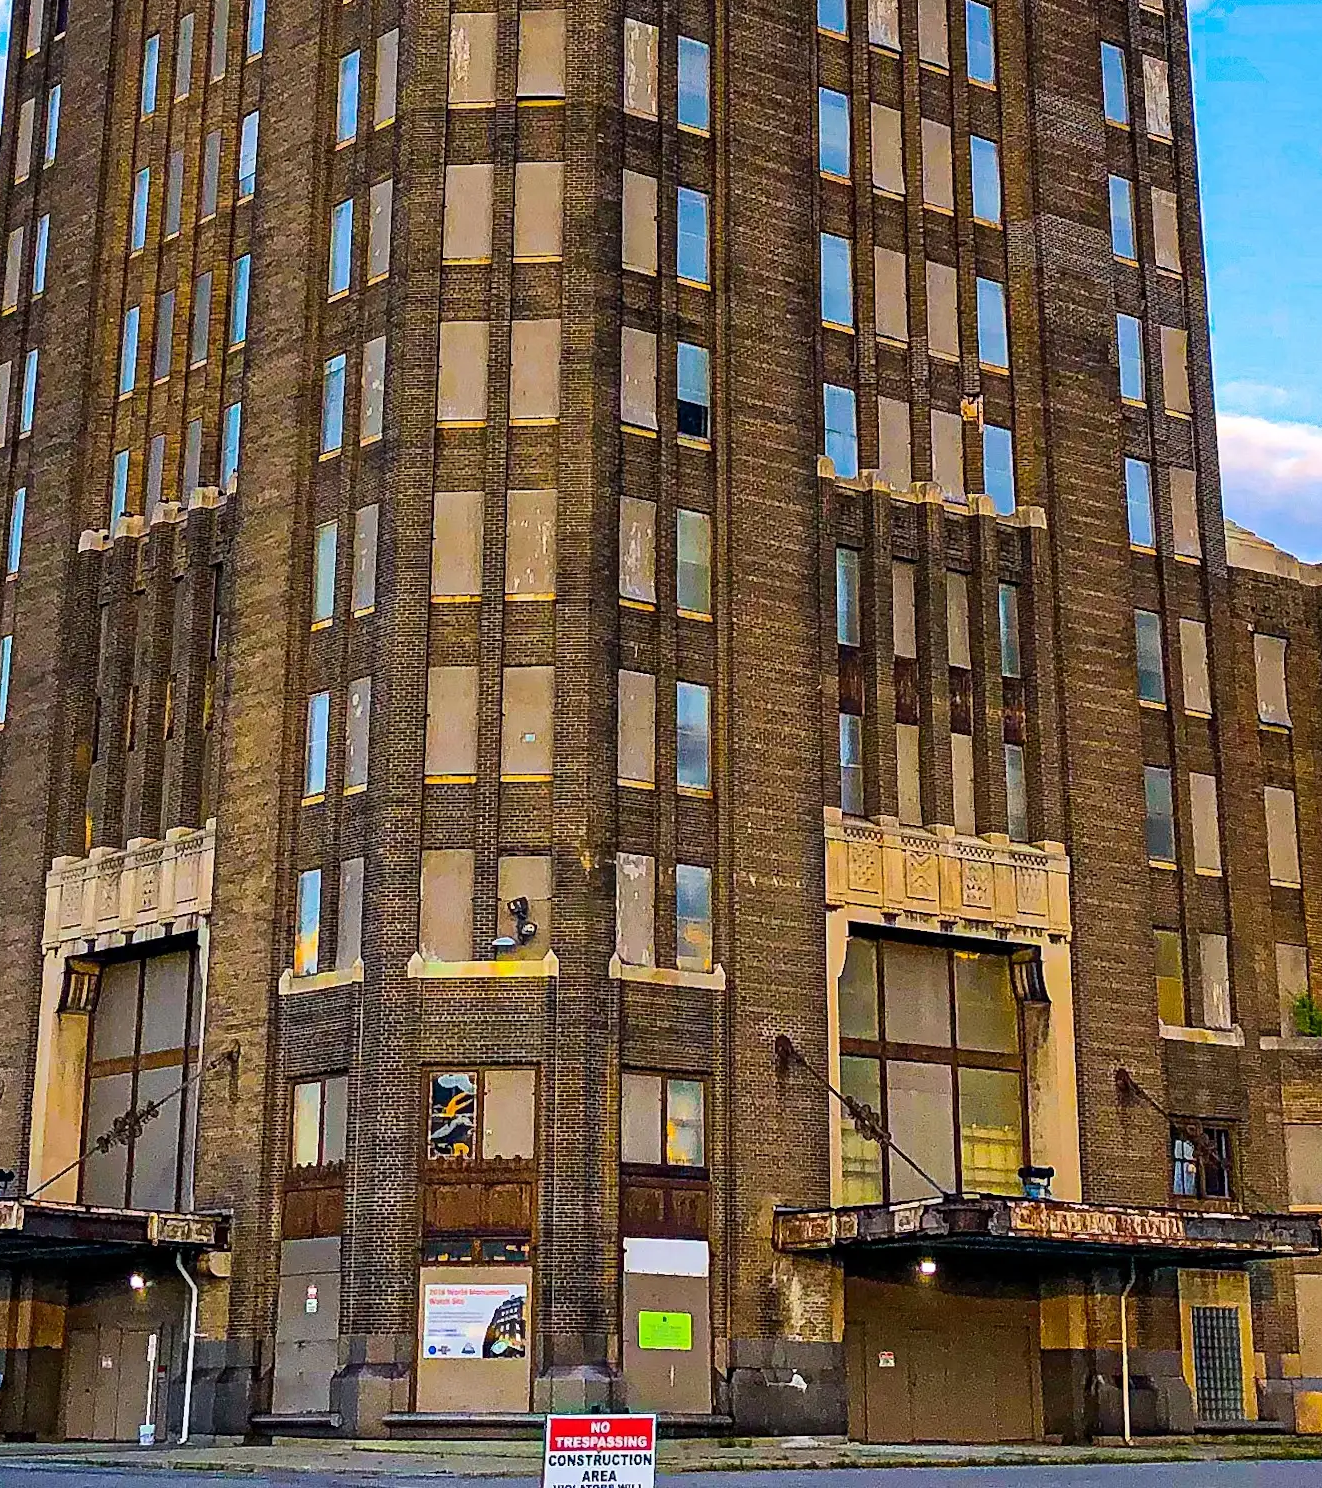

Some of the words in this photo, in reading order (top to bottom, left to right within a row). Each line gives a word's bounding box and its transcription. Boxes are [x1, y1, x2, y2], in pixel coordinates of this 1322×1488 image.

[590, 1421, 611, 1433] NO
[555, 1436, 648, 1448] TRESPASSING
[548, 1454, 652, 1466] CONSTRUCTION
[582, 1470, 617, 1482] AREA
